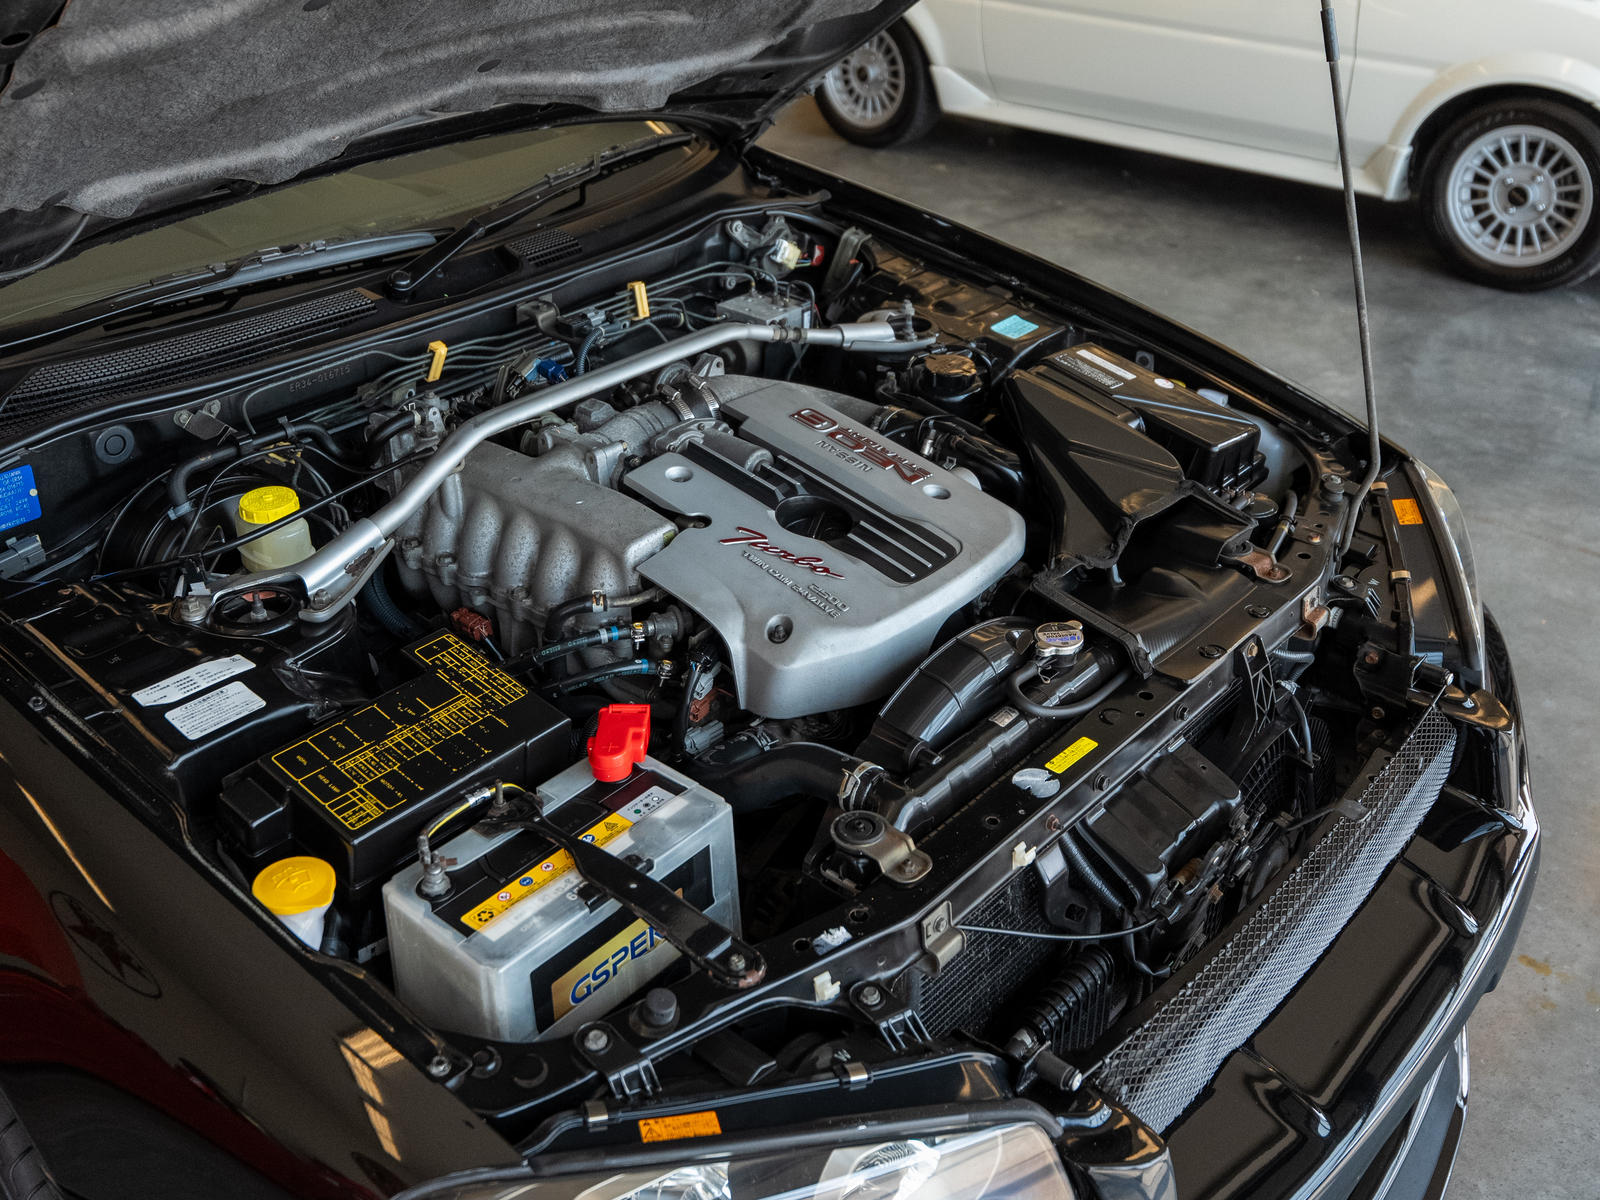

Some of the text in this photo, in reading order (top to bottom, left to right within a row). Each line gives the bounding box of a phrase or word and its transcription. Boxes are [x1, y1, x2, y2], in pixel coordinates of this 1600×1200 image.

[815, 439, 873, 473] NISSAN
[719, 526, 846, 580] Turbo
[742, 550, 769, 573] TWIN
[766, 568, 793, 588] CAM
